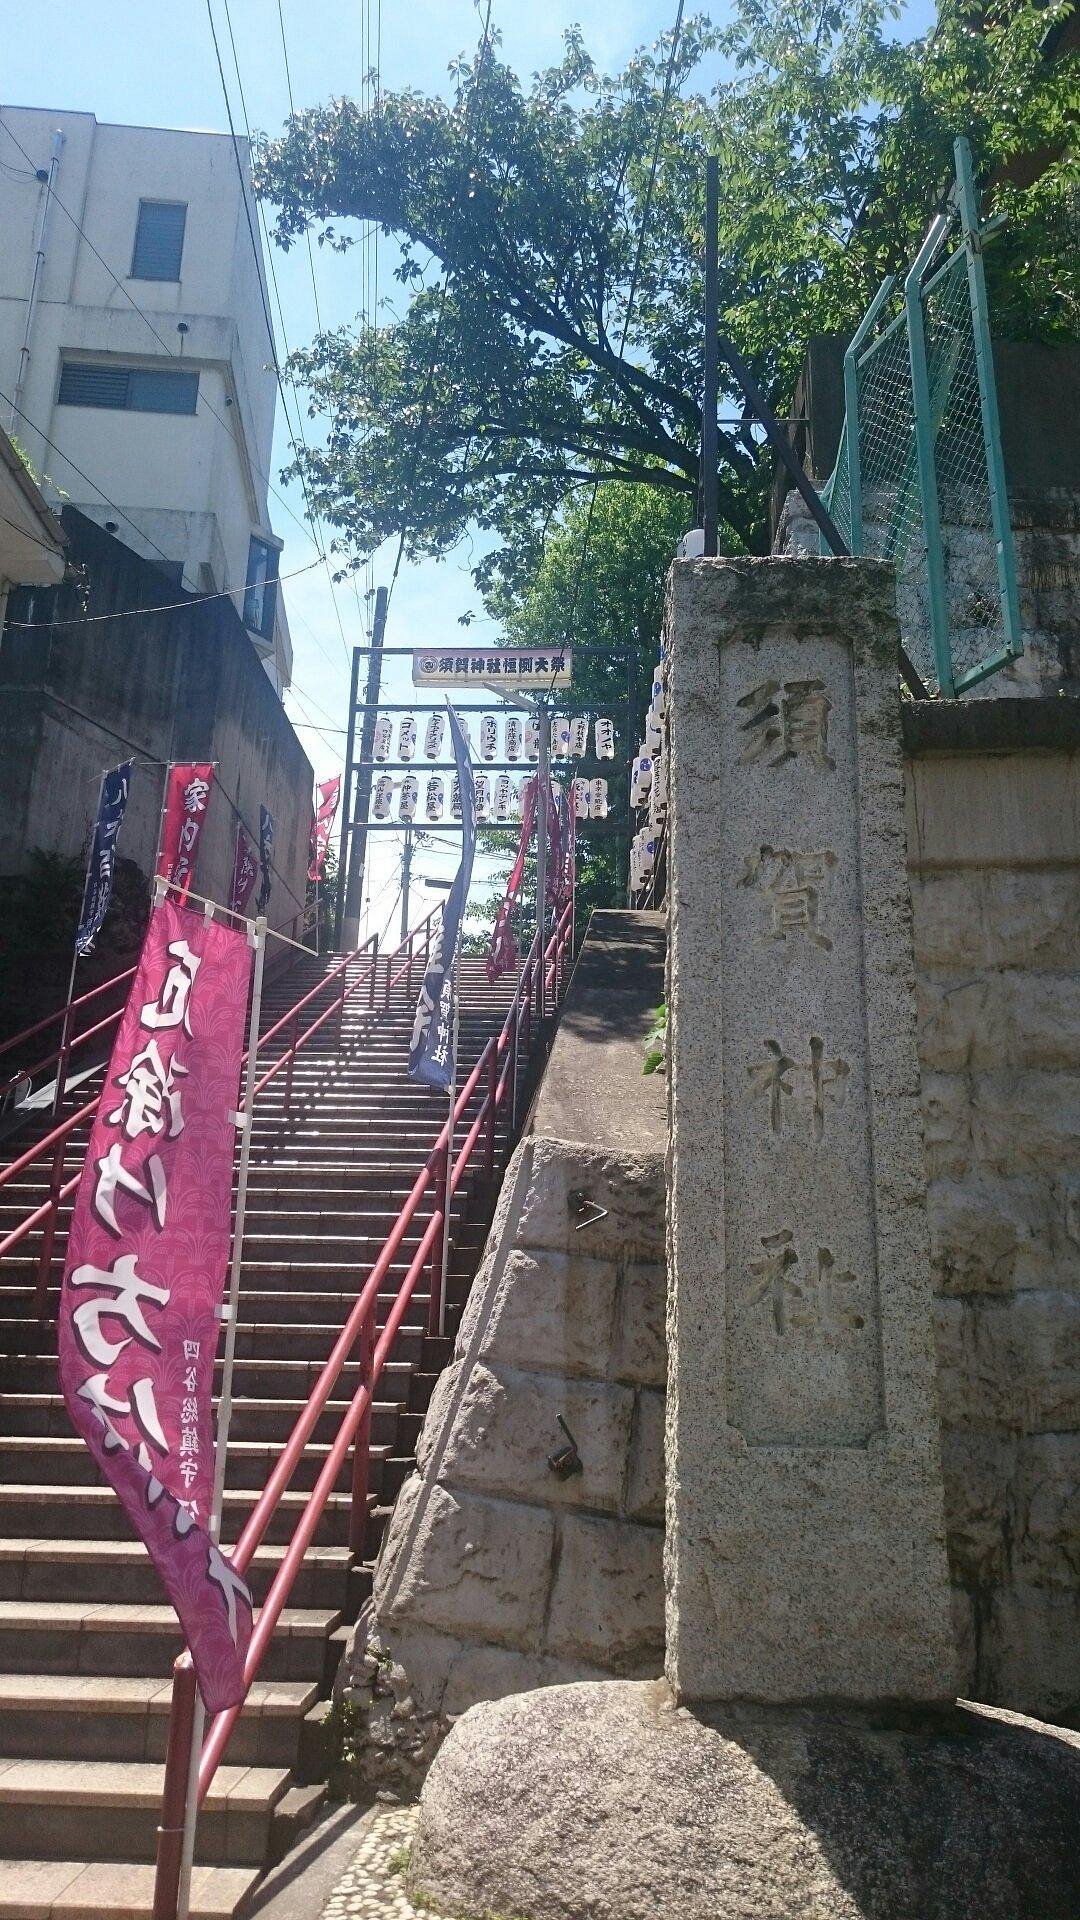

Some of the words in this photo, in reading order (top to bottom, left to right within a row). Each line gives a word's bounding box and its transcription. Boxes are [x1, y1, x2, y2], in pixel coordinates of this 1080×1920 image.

[438, 655, 566, 674] 須賀神社恒例大祭
[400, 721, 412, 751] コメット
[485, 720, 497, 751] ホリウチ
[600, 720, 613, 750] オオノヤ
[426, 781, 439, 812] 若松屋
[735, 677, 865, 1336] 須賀神社
